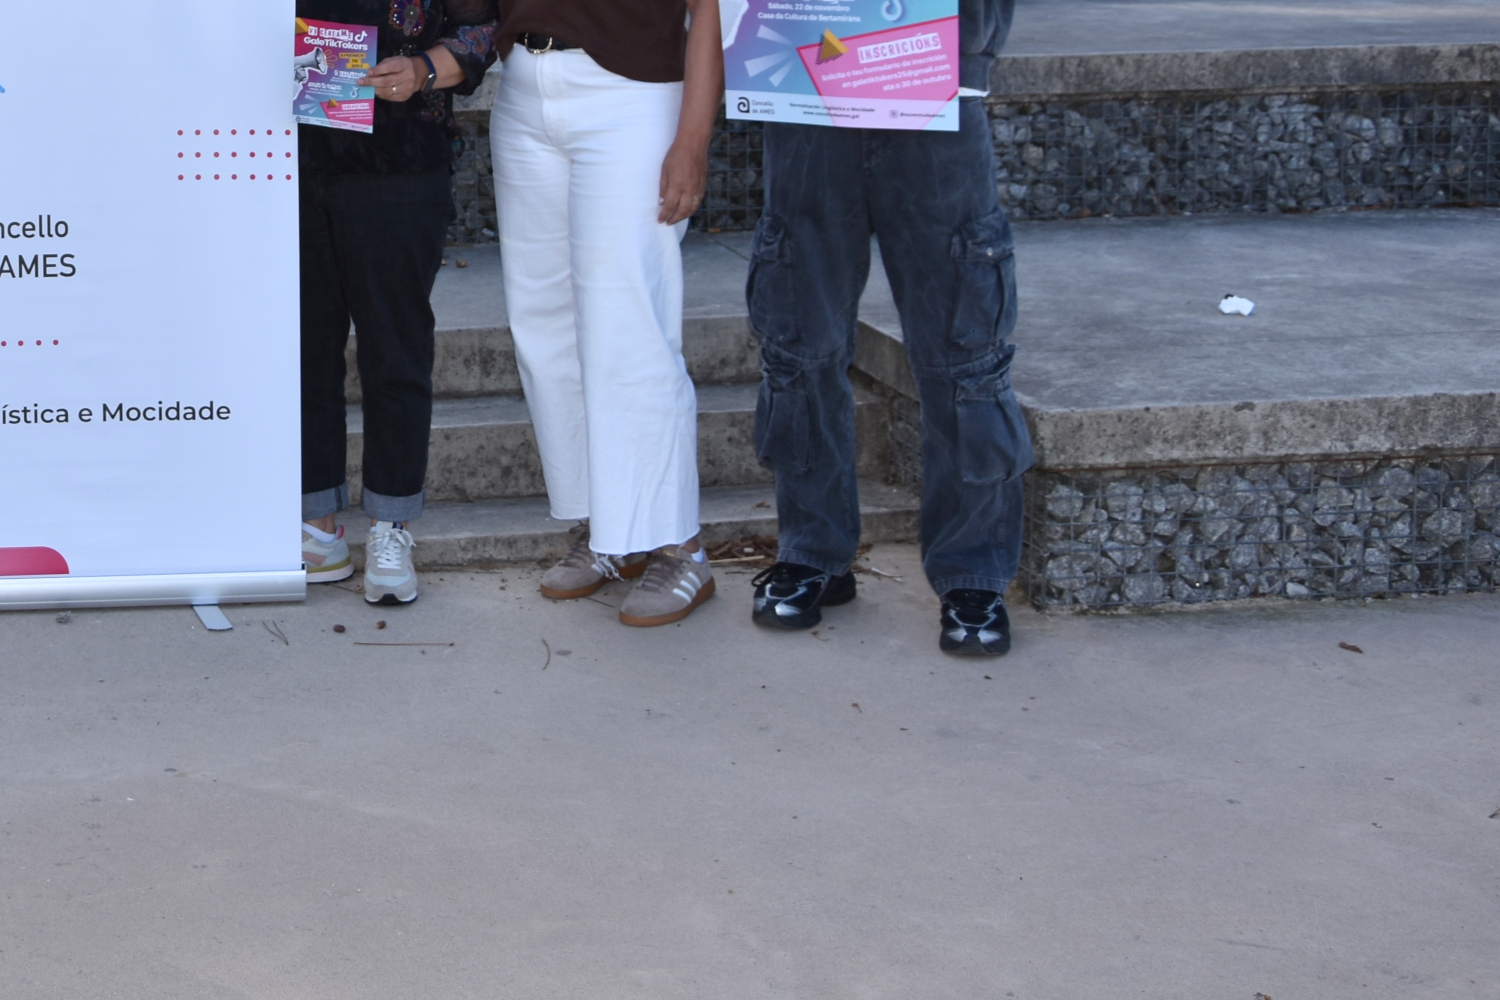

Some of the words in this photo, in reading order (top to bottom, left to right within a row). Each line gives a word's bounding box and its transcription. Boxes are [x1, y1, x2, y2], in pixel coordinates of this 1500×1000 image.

[304, 37, 368, 50] GaleTikTokers
[78, 408, 93, 422] e
[102, 401, 230, 423] Mocidade
